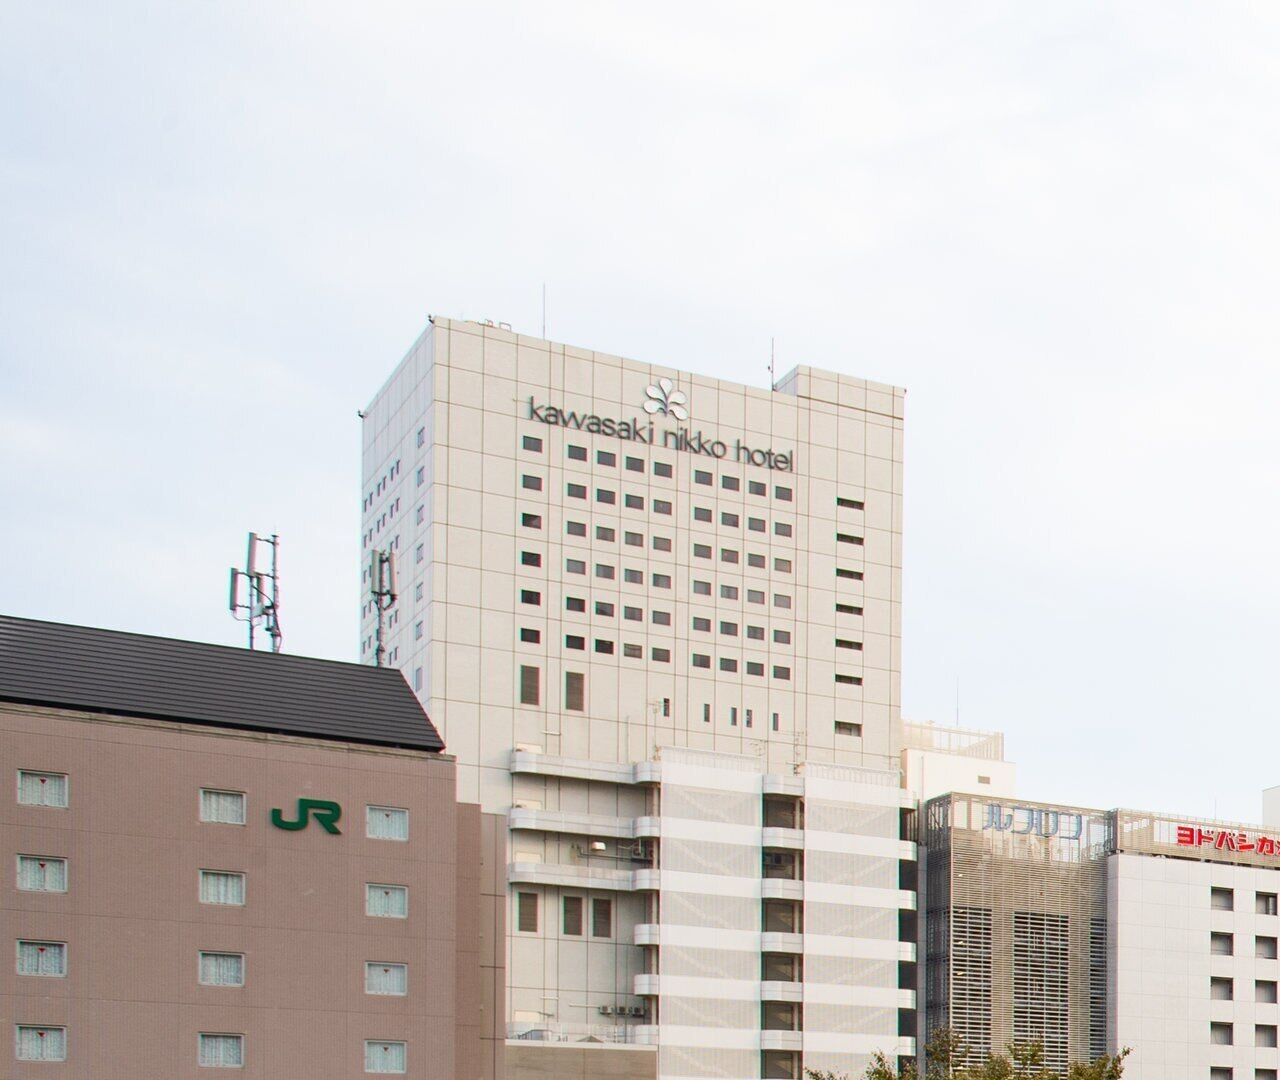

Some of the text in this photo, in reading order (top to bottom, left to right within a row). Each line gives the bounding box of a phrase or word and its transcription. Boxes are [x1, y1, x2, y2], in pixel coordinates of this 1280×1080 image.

[529, 396, 794, 472] kawasaki nikko hotel
[271, 797, 343, 836] JR
